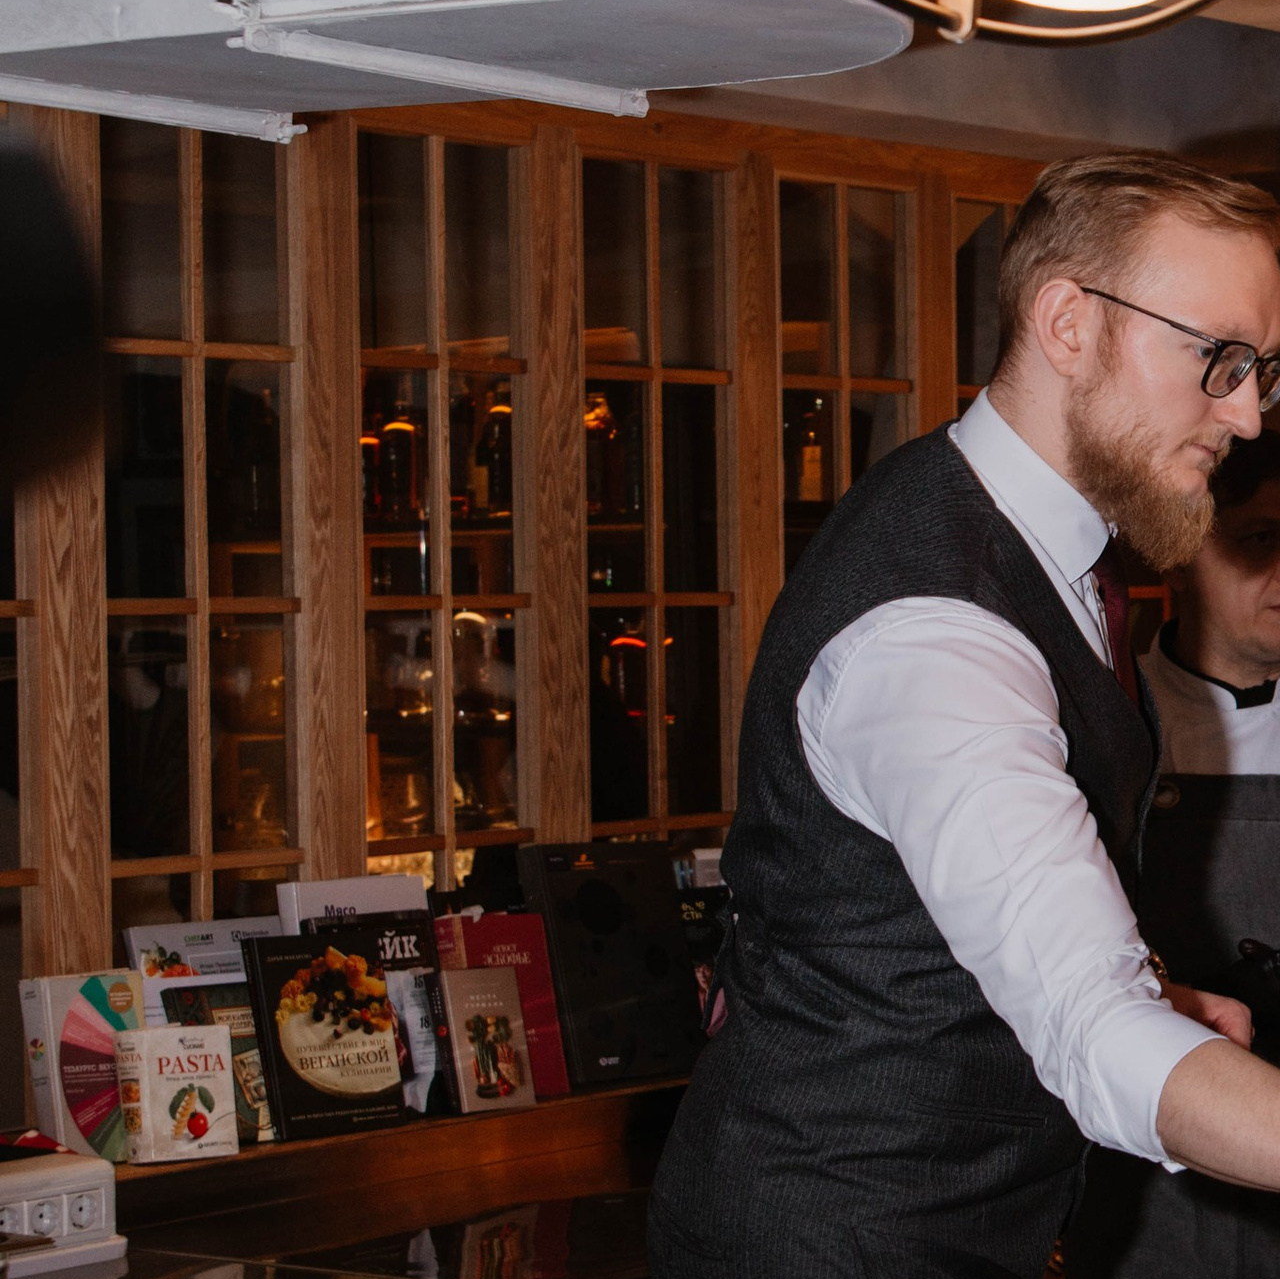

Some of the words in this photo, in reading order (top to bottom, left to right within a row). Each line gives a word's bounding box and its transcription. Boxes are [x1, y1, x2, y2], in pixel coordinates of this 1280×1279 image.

[324, 904, 356, 917] Мясо
[157, 1053, 226, 1075] PASTA
[299, 1046, 390, 1071] ВЕГАНСКОЙ
